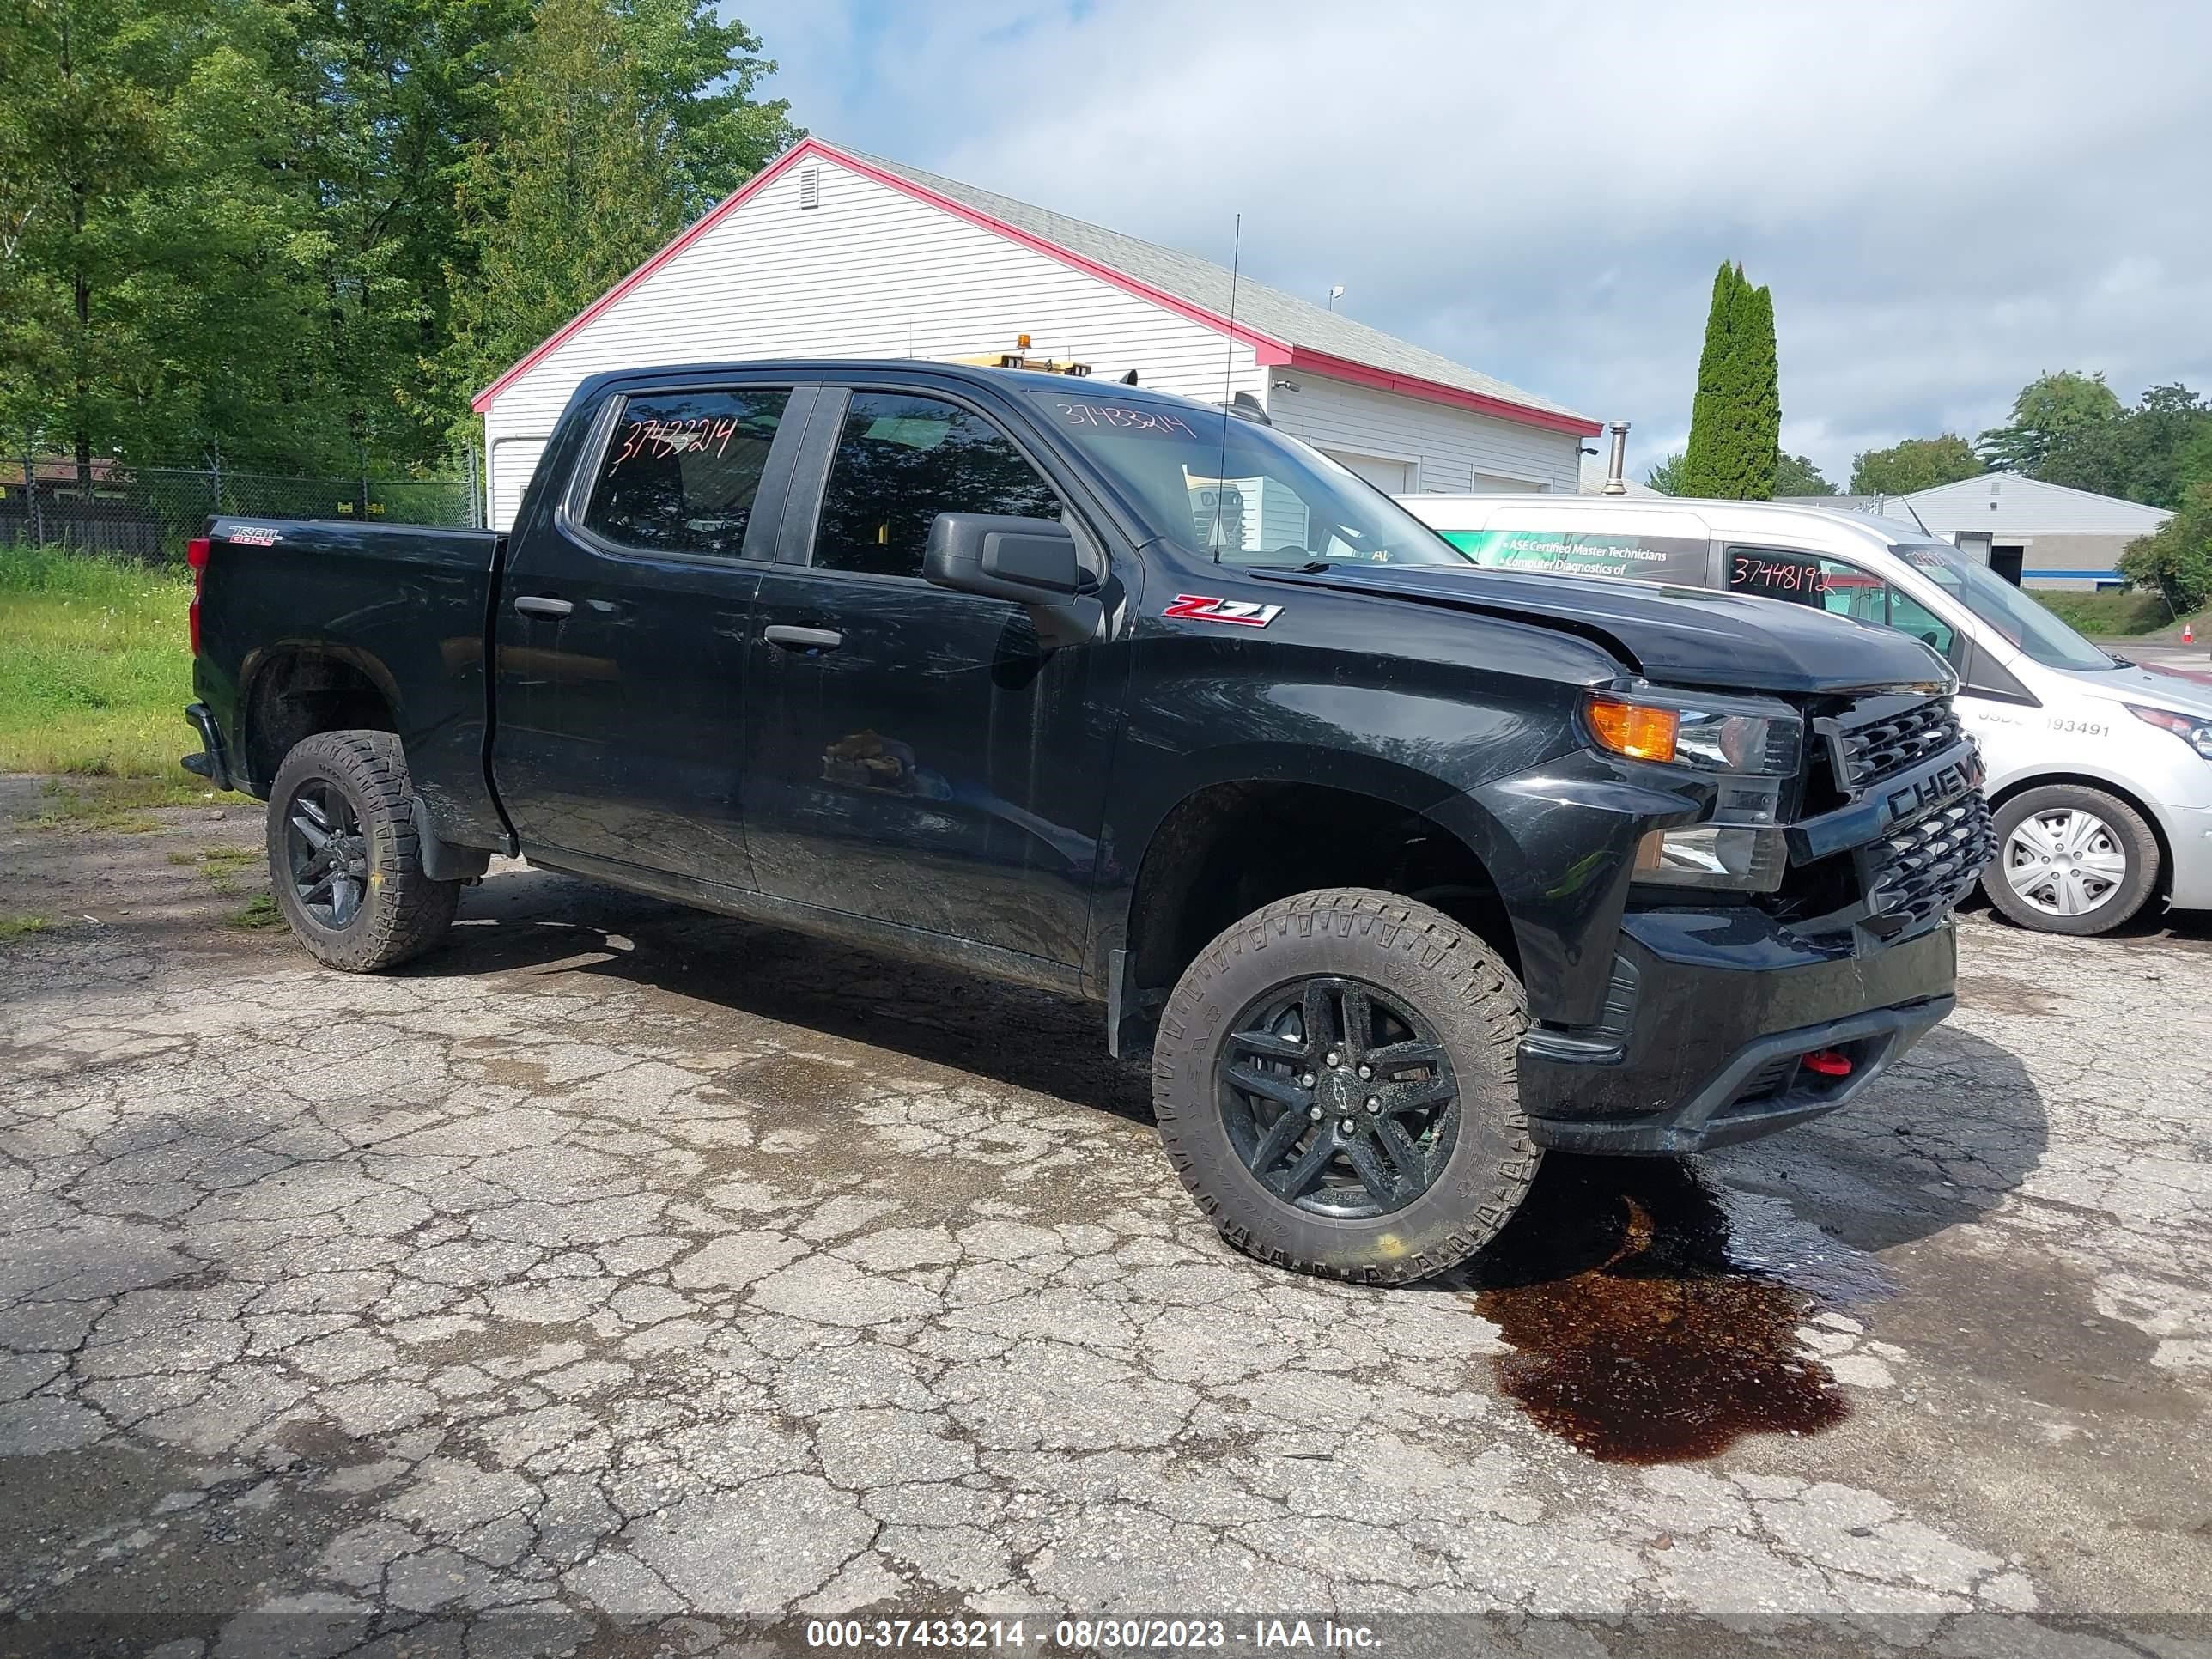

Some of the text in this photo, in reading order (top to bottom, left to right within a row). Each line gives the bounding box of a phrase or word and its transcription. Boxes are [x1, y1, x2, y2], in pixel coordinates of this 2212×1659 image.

[1057, 404, 1198, 439] 37433214
[612, 418, 738, 464] 37433214
[228, 526, 283, 540] TRAIL
[229, 535, 275, 546] BOSS
[1509, 540, 1667, 562] ASE Certified Master Technicians
[1506, 557, 1626, 575] Computer Diagnostics of
[1730, 557, 1836, 595] 37448192
[1161, 593, 1285, 629] Z71
